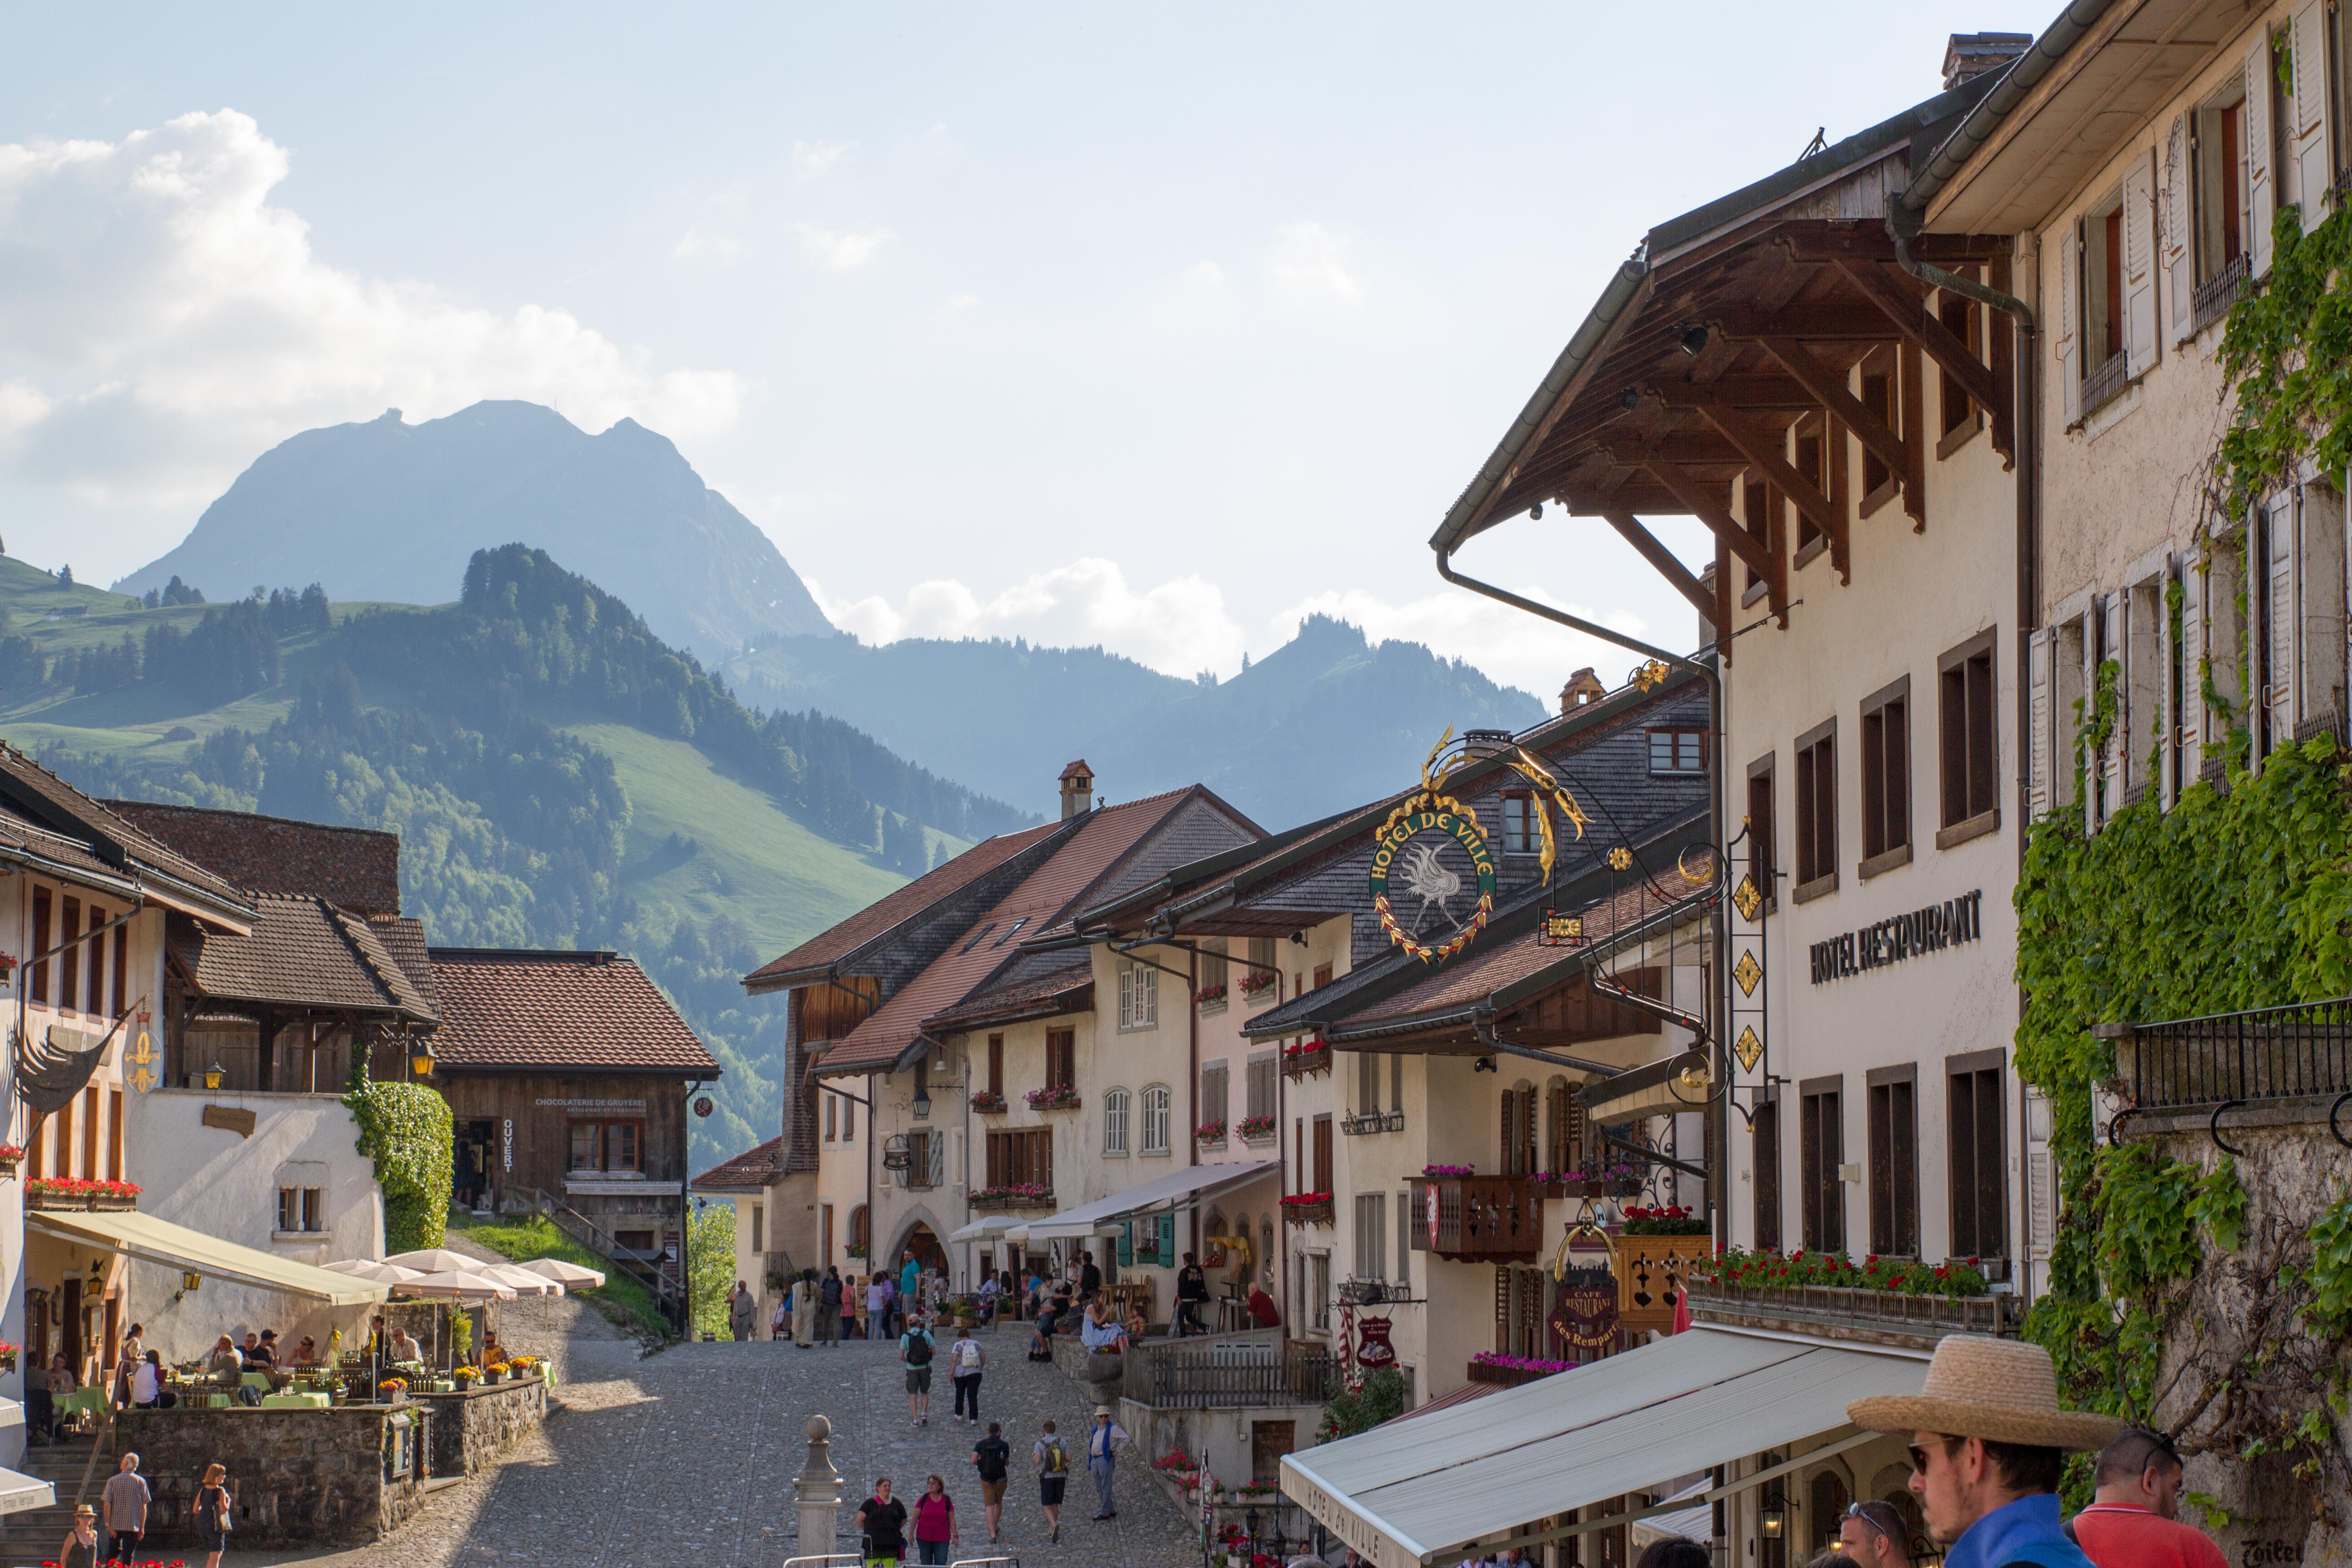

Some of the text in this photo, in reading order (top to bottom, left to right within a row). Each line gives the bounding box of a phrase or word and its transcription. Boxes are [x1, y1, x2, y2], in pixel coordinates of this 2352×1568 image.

[1371, 812, 1494, 879] HOTEL DE VILLE
[1809, 888, 1982, 985] HOTEL RESTAURANT
[608, 1098, 647, 1106] GRUYÈRES
[504, 1119, 513, 1173] OUVERT
[1554, 1320, 1617, 1347] des Rempart
[1566, 1298, 1610, 1318] RESTAURANT
[1308, 1485, 1378, 1558] HOTEL de VILLE
